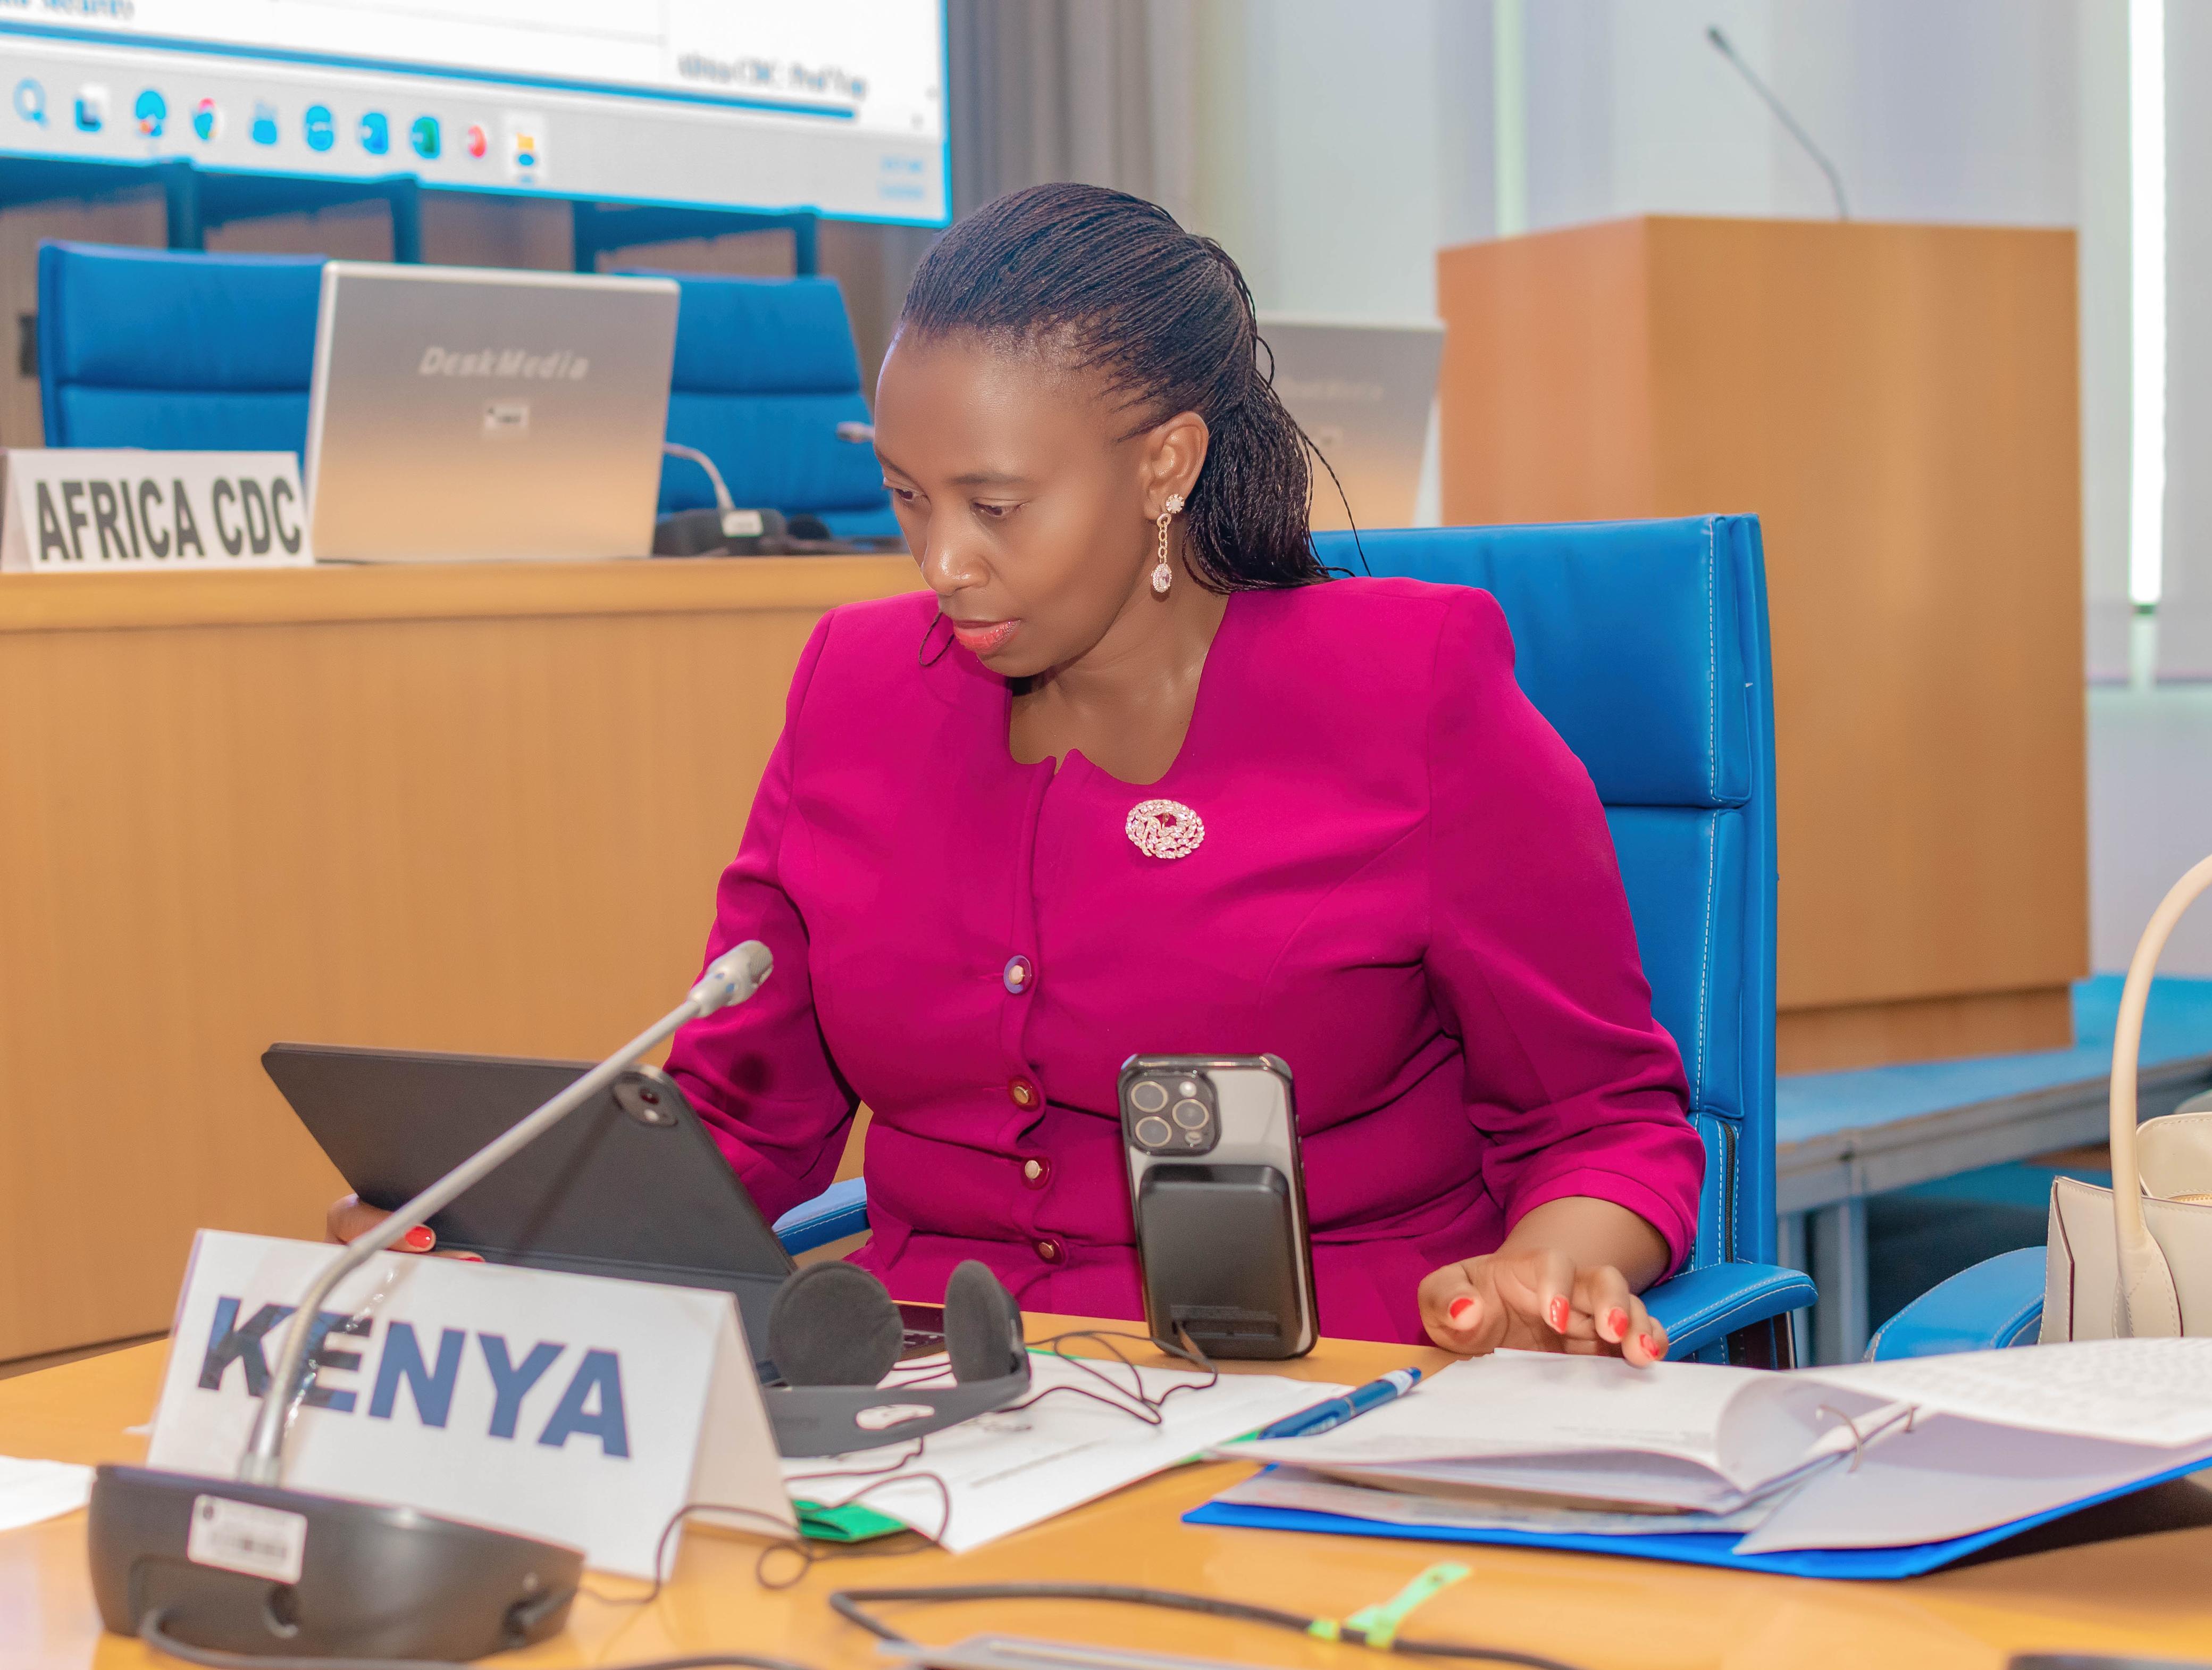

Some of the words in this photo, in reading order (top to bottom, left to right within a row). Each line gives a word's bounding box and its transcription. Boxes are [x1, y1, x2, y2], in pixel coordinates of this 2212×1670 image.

[35, 479, 205, 562] AFRICA
[212, 477, 301, 556] CDC
[197, 1296, 631, 1458] KENYA
